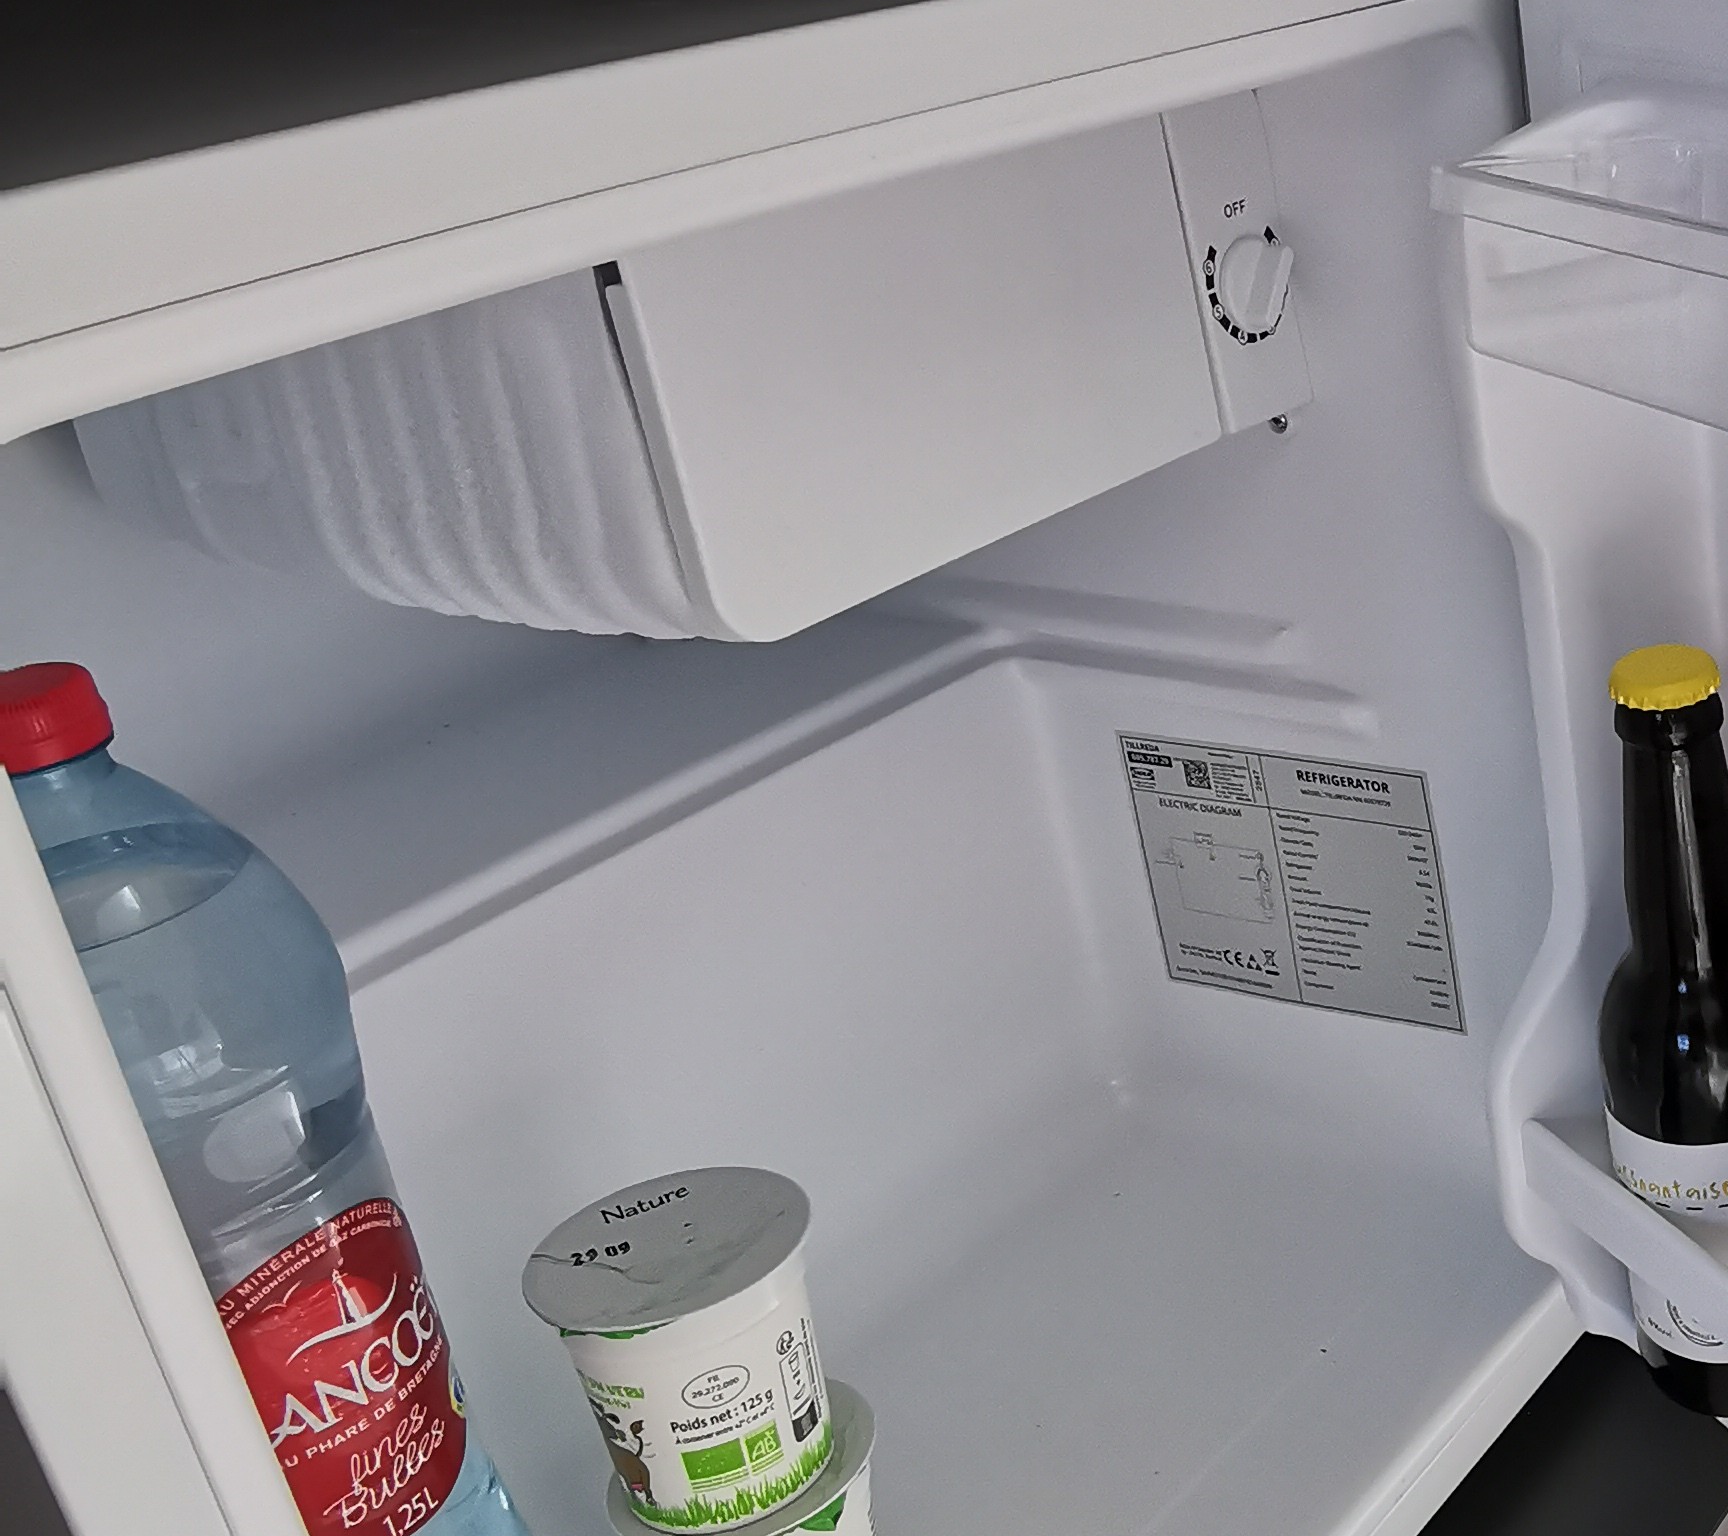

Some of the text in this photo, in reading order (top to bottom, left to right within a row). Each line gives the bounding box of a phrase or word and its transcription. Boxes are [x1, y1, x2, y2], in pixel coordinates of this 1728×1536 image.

[1223, 199, 1247, 218] OFF
[1296, 770, 1390, 794] REFRIGERATOR
[1159, 797, 1242, 817] ELECTRIC DIAGRAM
[600, 1187, 690, 1224] Nature
[313, 1246, 327, 1258] DE
[570, 1242, 630, 1266] 29 09
[670, 1415, 707, 1433] Poids
[711, 1409, 733, 1425] net
[741, 1395, 764, 1412] 125
[765, 1389, 773, 1405] g
[305, 1420, 371, 1460] PHARE
[374, 1399, 396, 1421] DE
[350, 1403, 428, 1497] fines
